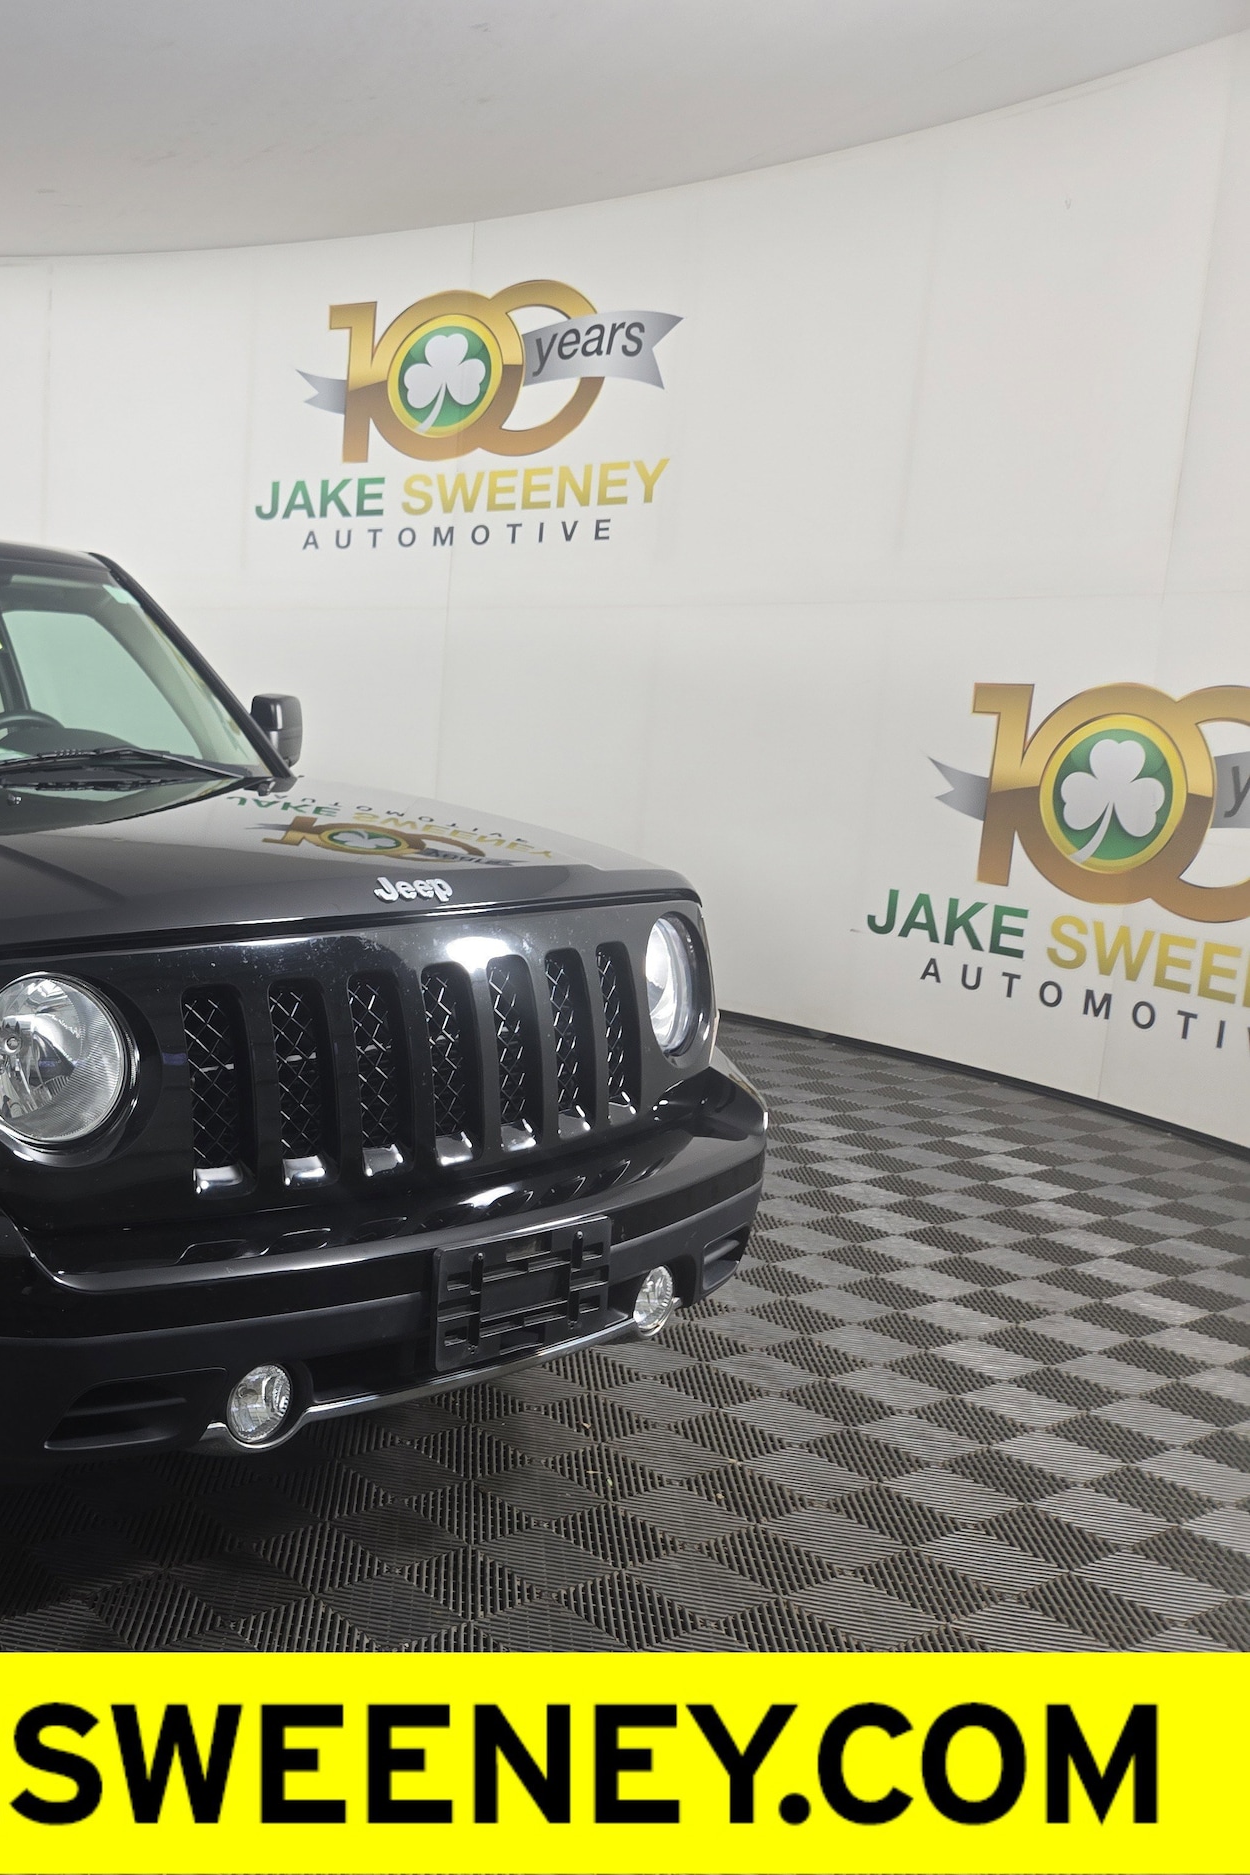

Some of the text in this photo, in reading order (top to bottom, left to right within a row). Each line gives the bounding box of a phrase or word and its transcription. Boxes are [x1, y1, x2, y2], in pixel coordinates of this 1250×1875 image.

[532, 318, 646, 378] years
[254, 457, 670, 521] JAKE SWEENEY
[302, 518, 612, 551] AUTOMOTIVE
[374, 876, 454, 903] Jeep
[866, 888, 1250, 1009] JAKE SWEE
[919, 957, 1250, 1056] AUTOMOTI
